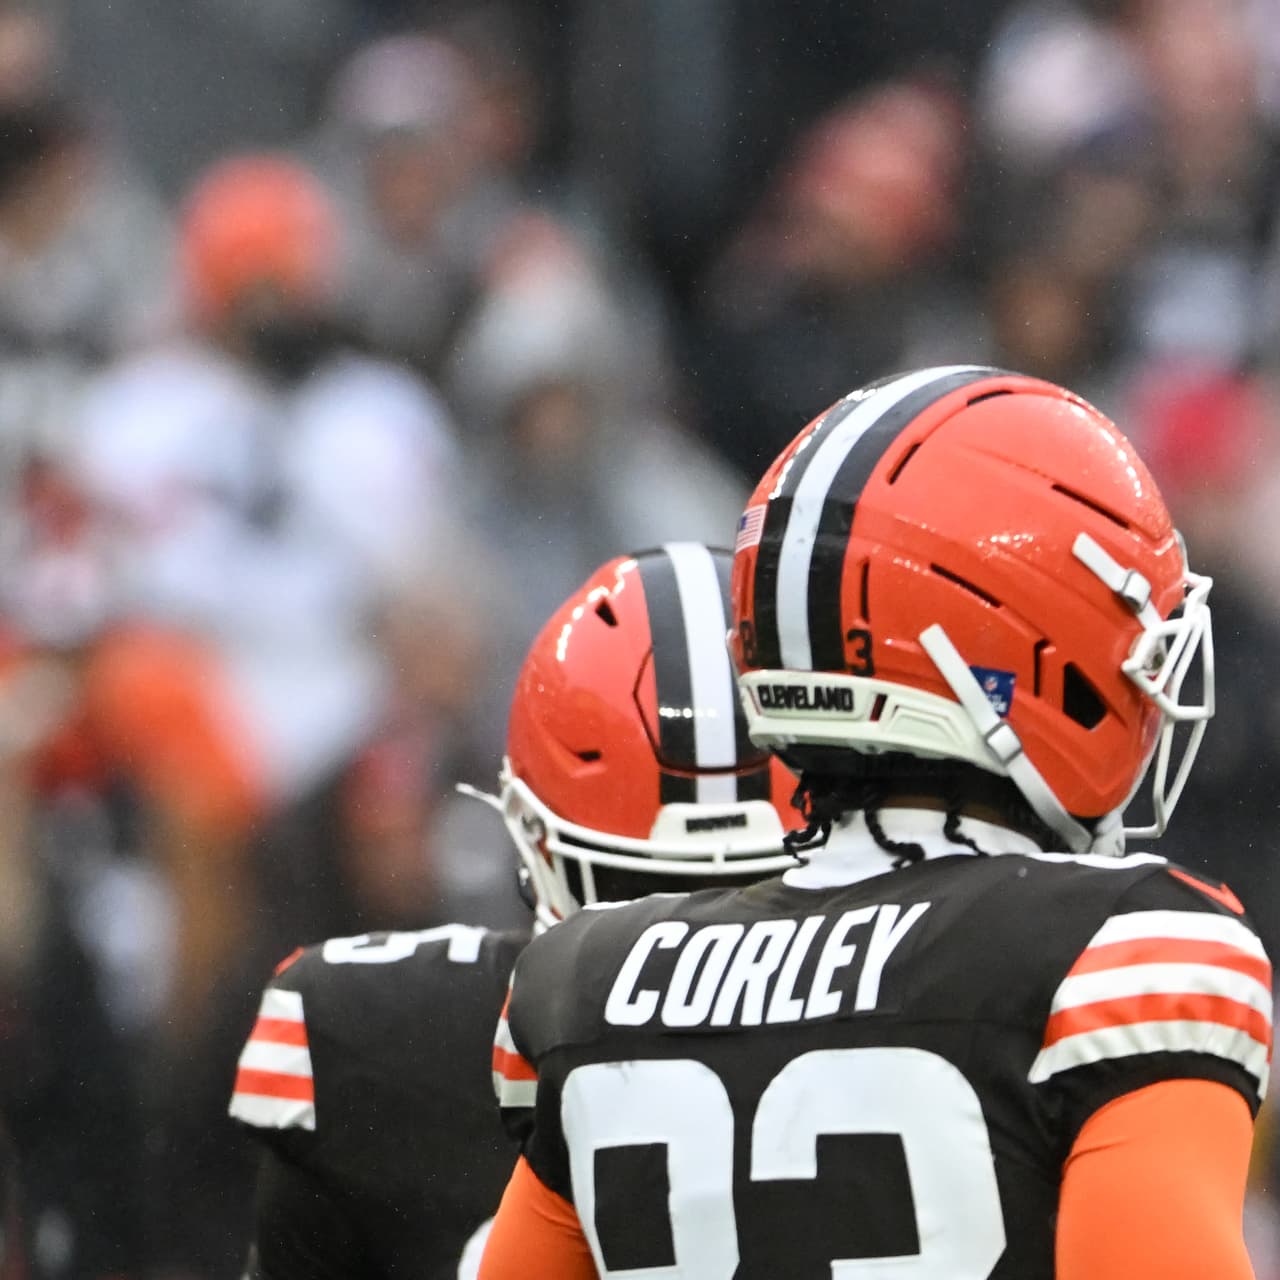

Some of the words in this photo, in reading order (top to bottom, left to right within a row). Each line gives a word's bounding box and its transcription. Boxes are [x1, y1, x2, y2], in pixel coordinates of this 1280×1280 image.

[846, 628, 875, 677] 3
[757, 684, 855, 712] CLEVELAND
[604, 902, 931, 1028] CORLEY
